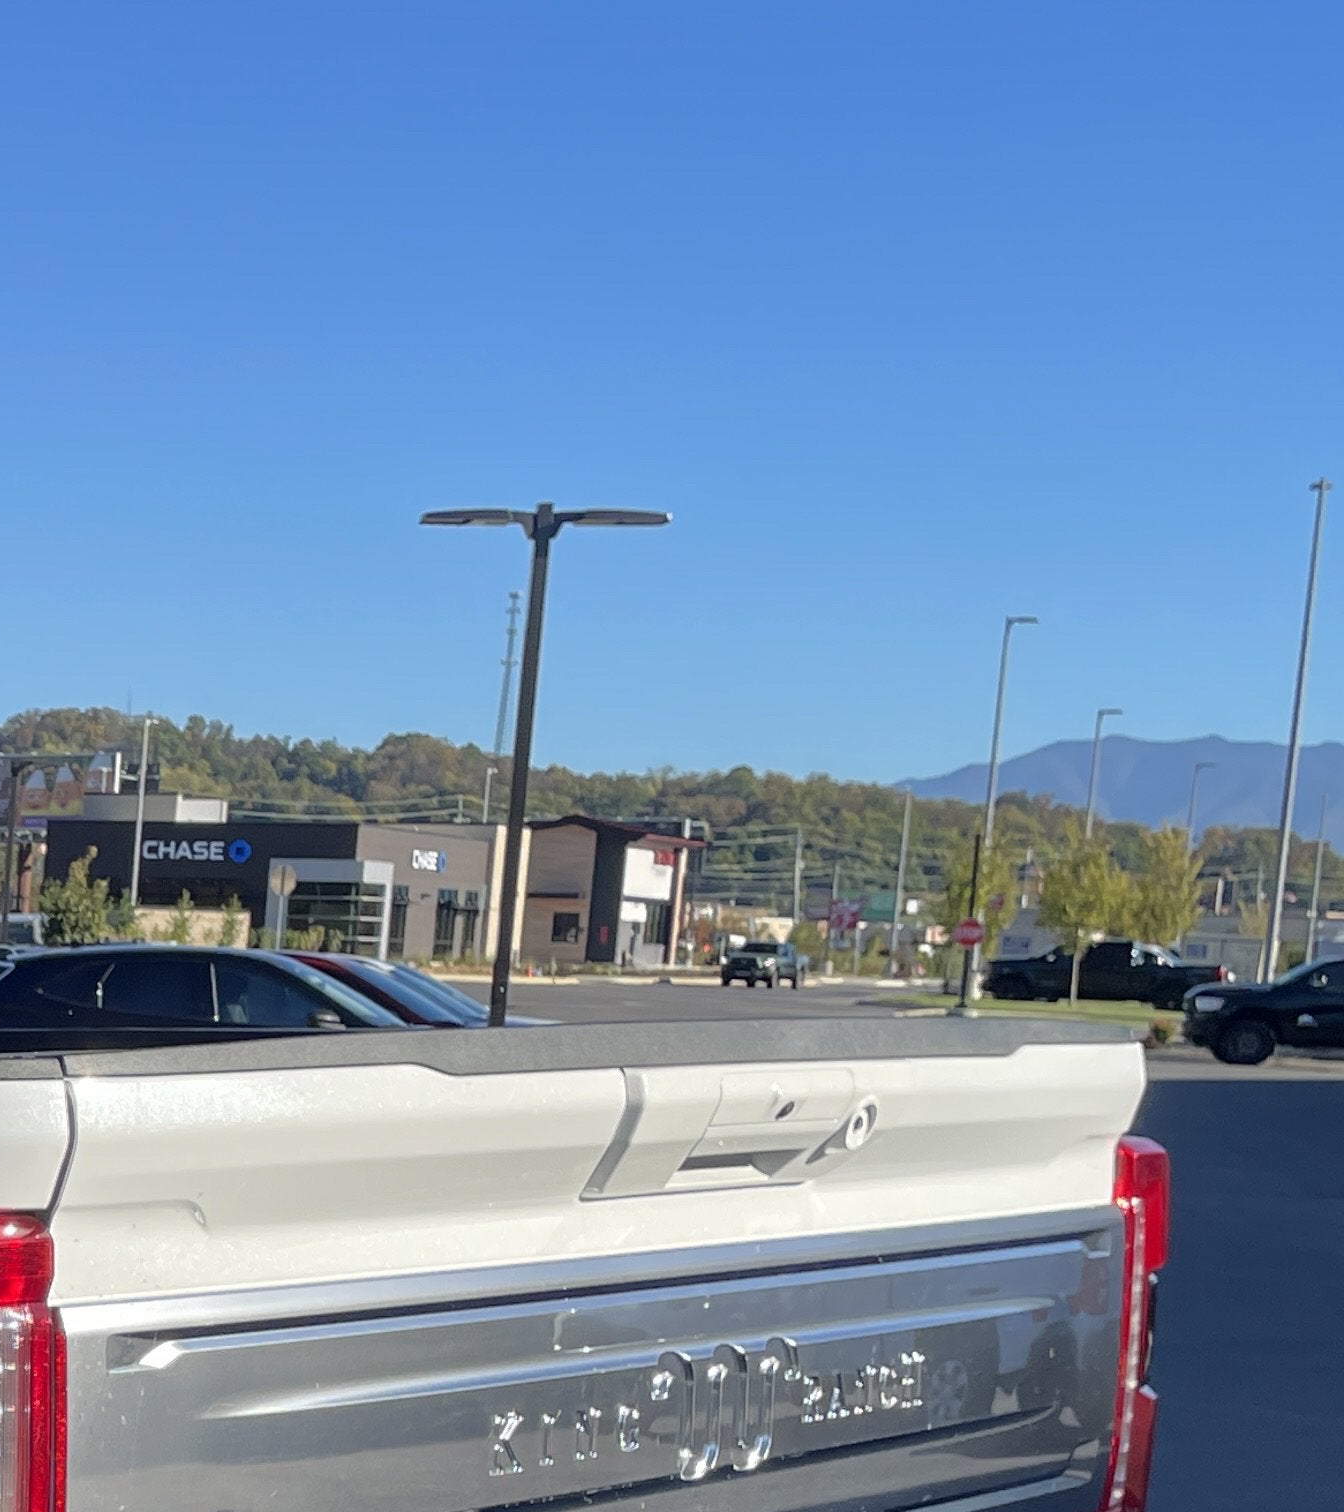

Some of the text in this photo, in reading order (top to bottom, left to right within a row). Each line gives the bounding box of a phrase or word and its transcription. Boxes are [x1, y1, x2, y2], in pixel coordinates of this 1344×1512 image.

[142, 840, 225, 861] CHASE
[411, 849, 439, 871] CHASE
[488, 1349, 928, 1477] KING RANCH
